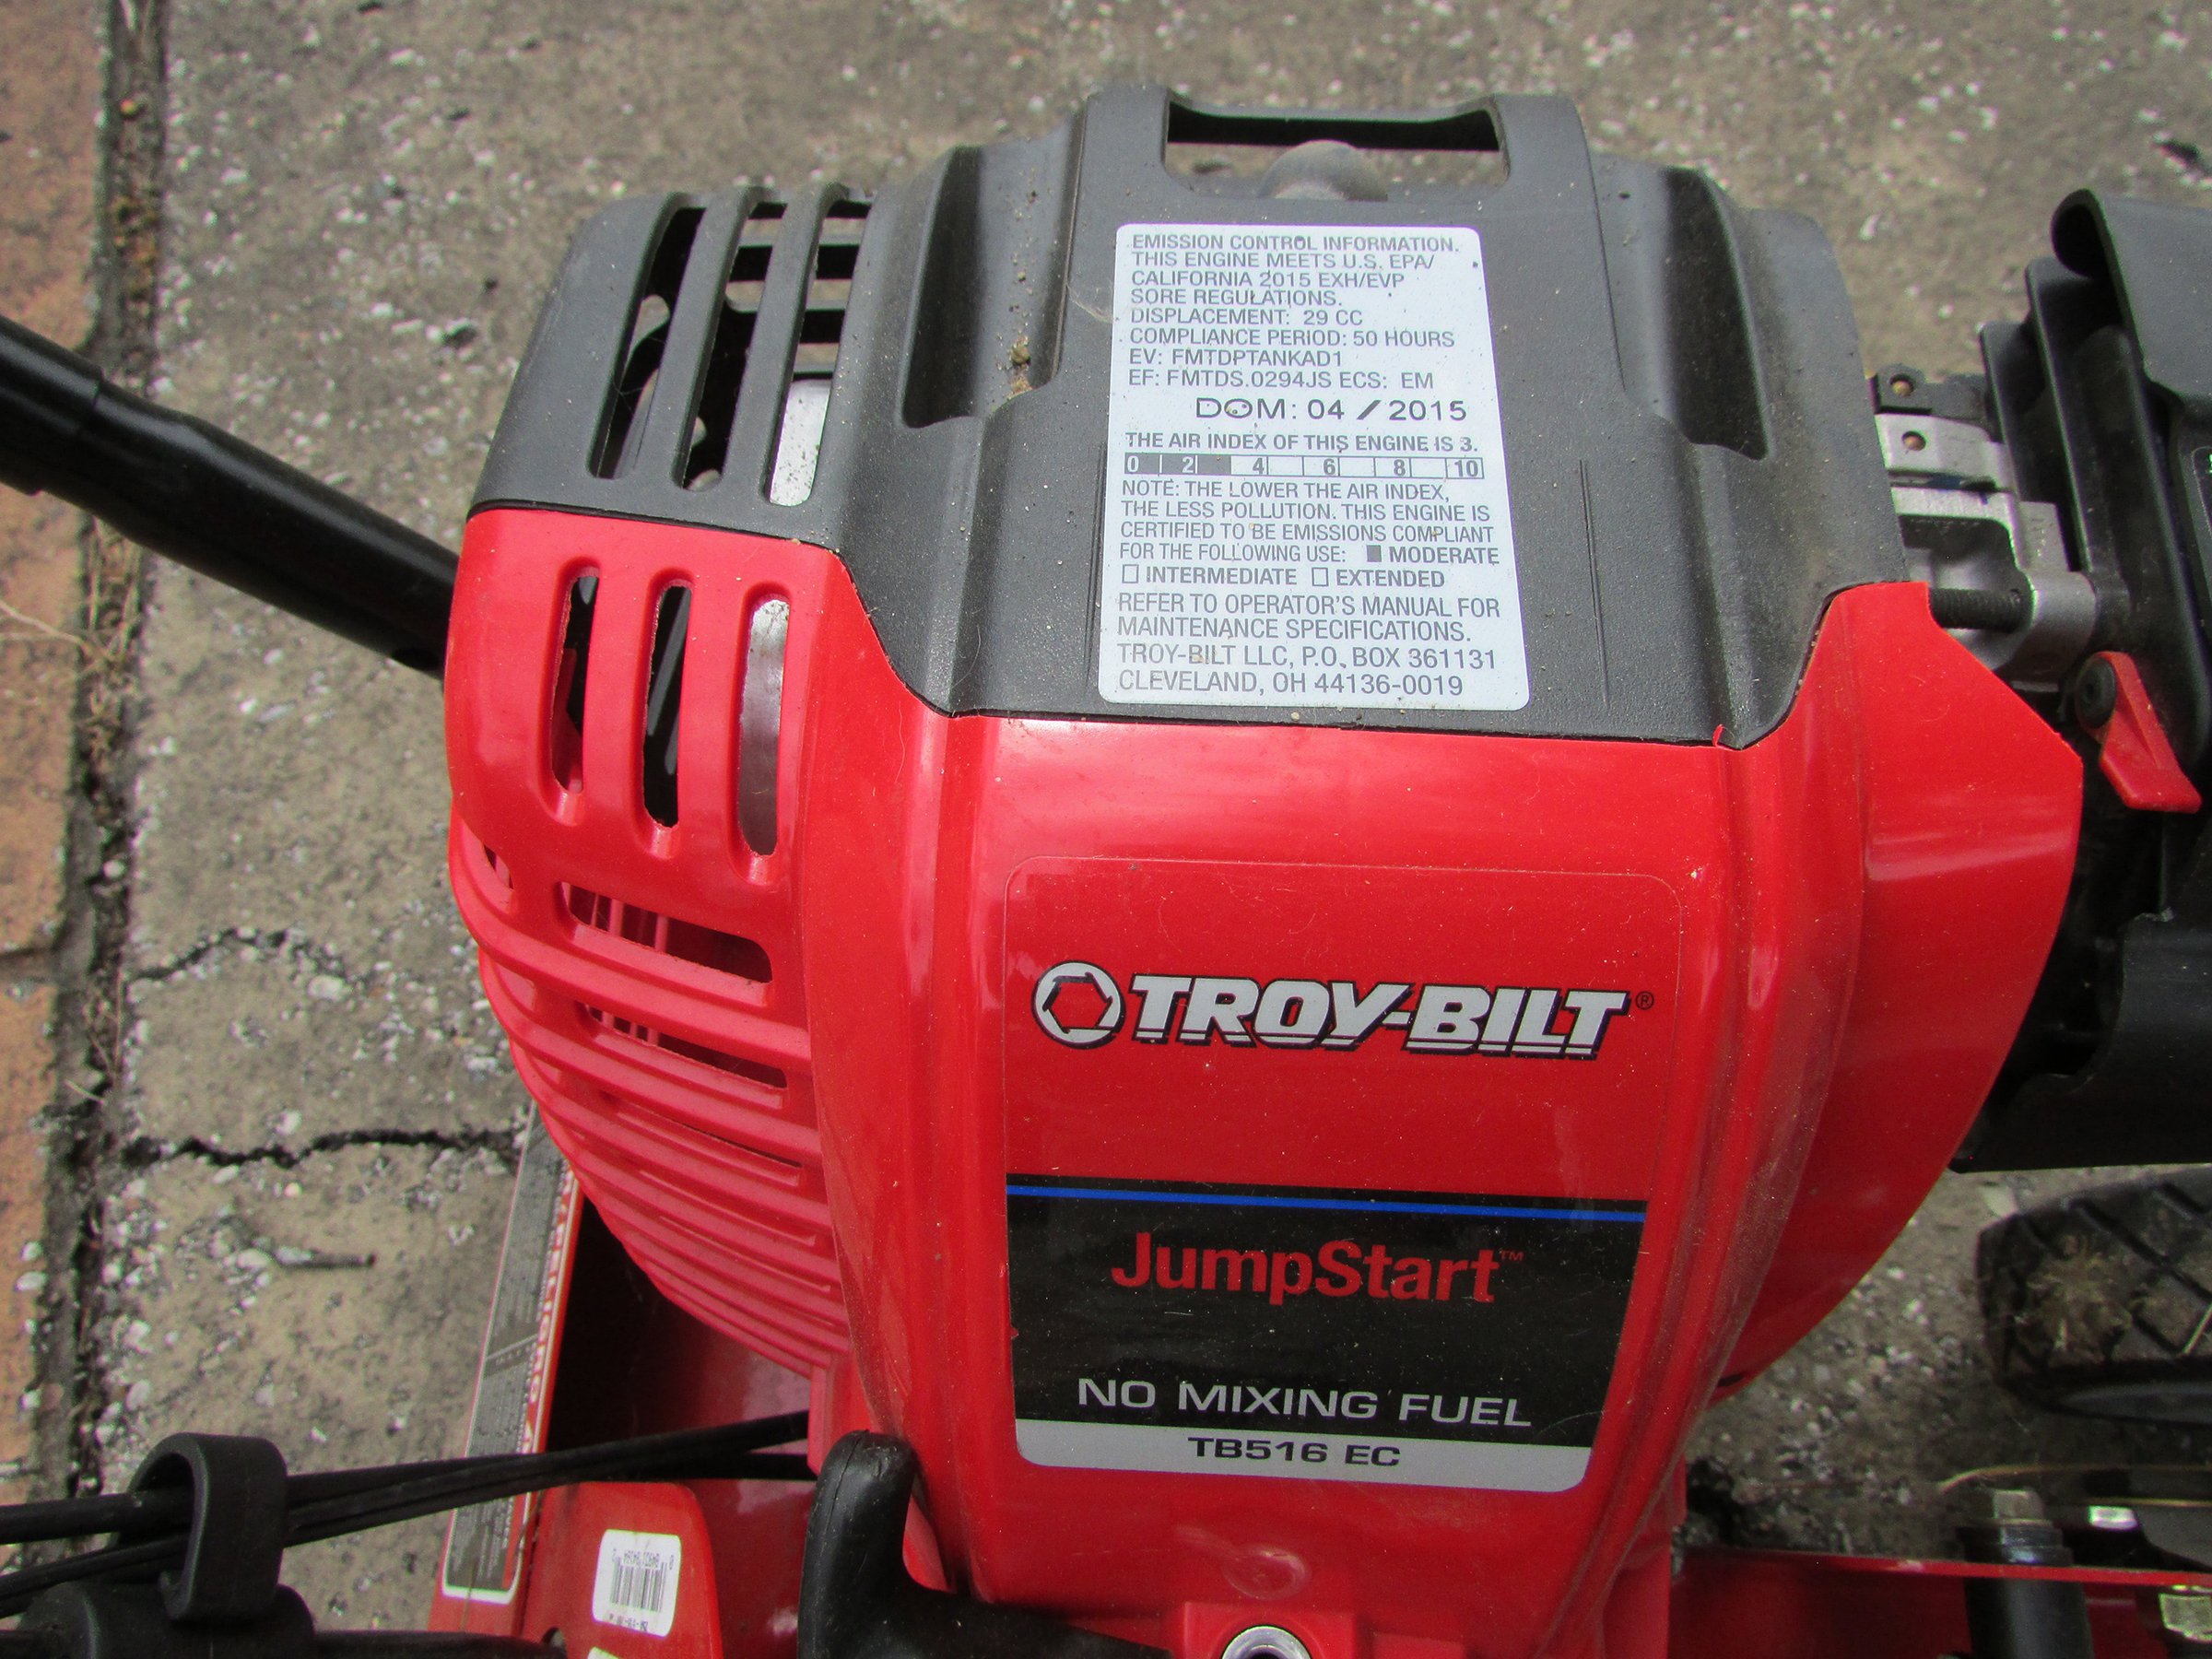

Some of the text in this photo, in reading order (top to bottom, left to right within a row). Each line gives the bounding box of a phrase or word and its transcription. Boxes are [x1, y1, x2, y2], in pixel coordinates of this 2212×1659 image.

[1132, 235, 1459, 252] EMISSION CONTROL INFORMATION.
[1132, 252, 1435, 269] THIS ENGINE MEETS U.S. EPA/
[1131, 271, 1405, 288] CALIFORNIA 2015 EXH/EVP
[1130, 290, 1342, 306] SORE REGULATIONS.
[1130, 309, 1363, 325] DISPLACEMENT: 29 CC
[1130, 329, 1454, 347] COMPLIANCE PERIOD: 50 HOURS
[1130, 349, 1342, 366] EV: FMTDPTANKAD1
[1129, 371, 1433, 388] EF: FMTDS.0294JS ECS: EM
[1196, 398, 1297, 419] DOM:
[1307, 399, 1345, 419] 04
[1389, 400, 1467, 420] 2015
[1125, 432, 1478, 453] THE AIR INDEX OF THIS ENGINE IS 3.
[1126, 456, 1478, 477] 0 2 4 6 8 10
[1122, 480, 1449, 502] NOTE: THE LOWER THE AIR INDEX,
[1122, 501, 1489, 522] THE LESS POLLUTION. THIS ENGINE IS
[1121, 522, 1494, 543] CERTIFIED TO BE EMISSIONS COMPLIANT
[1120, 543, 1500, 565] FOR THE FOLLOWING USE: MODERATE
[1147, 566, 1444, 587] INTERMEDIATE EXTENDED
[1119, 594, 1500, 618] REFER TO OPERATOR'S MANUAL FOR
[1118, 617, 1471, 641] MAINTENANCE SPECIFICATIONS.
[1118, 643, 1496, 669] TROY-BILT LLC, P.O. BOX 361131
[1119, 671, 1464, 697] CLEVELAND, OH 44136-0019
[1130, 972, 1631, 1061] TROY-BILT
[1111, 1232, 1499, 1305] JumpStart
[1077, 1377, 1532, 1427] NO MIXING FUEL
[1188, 1436, 1401, 1466] TB516 EC
